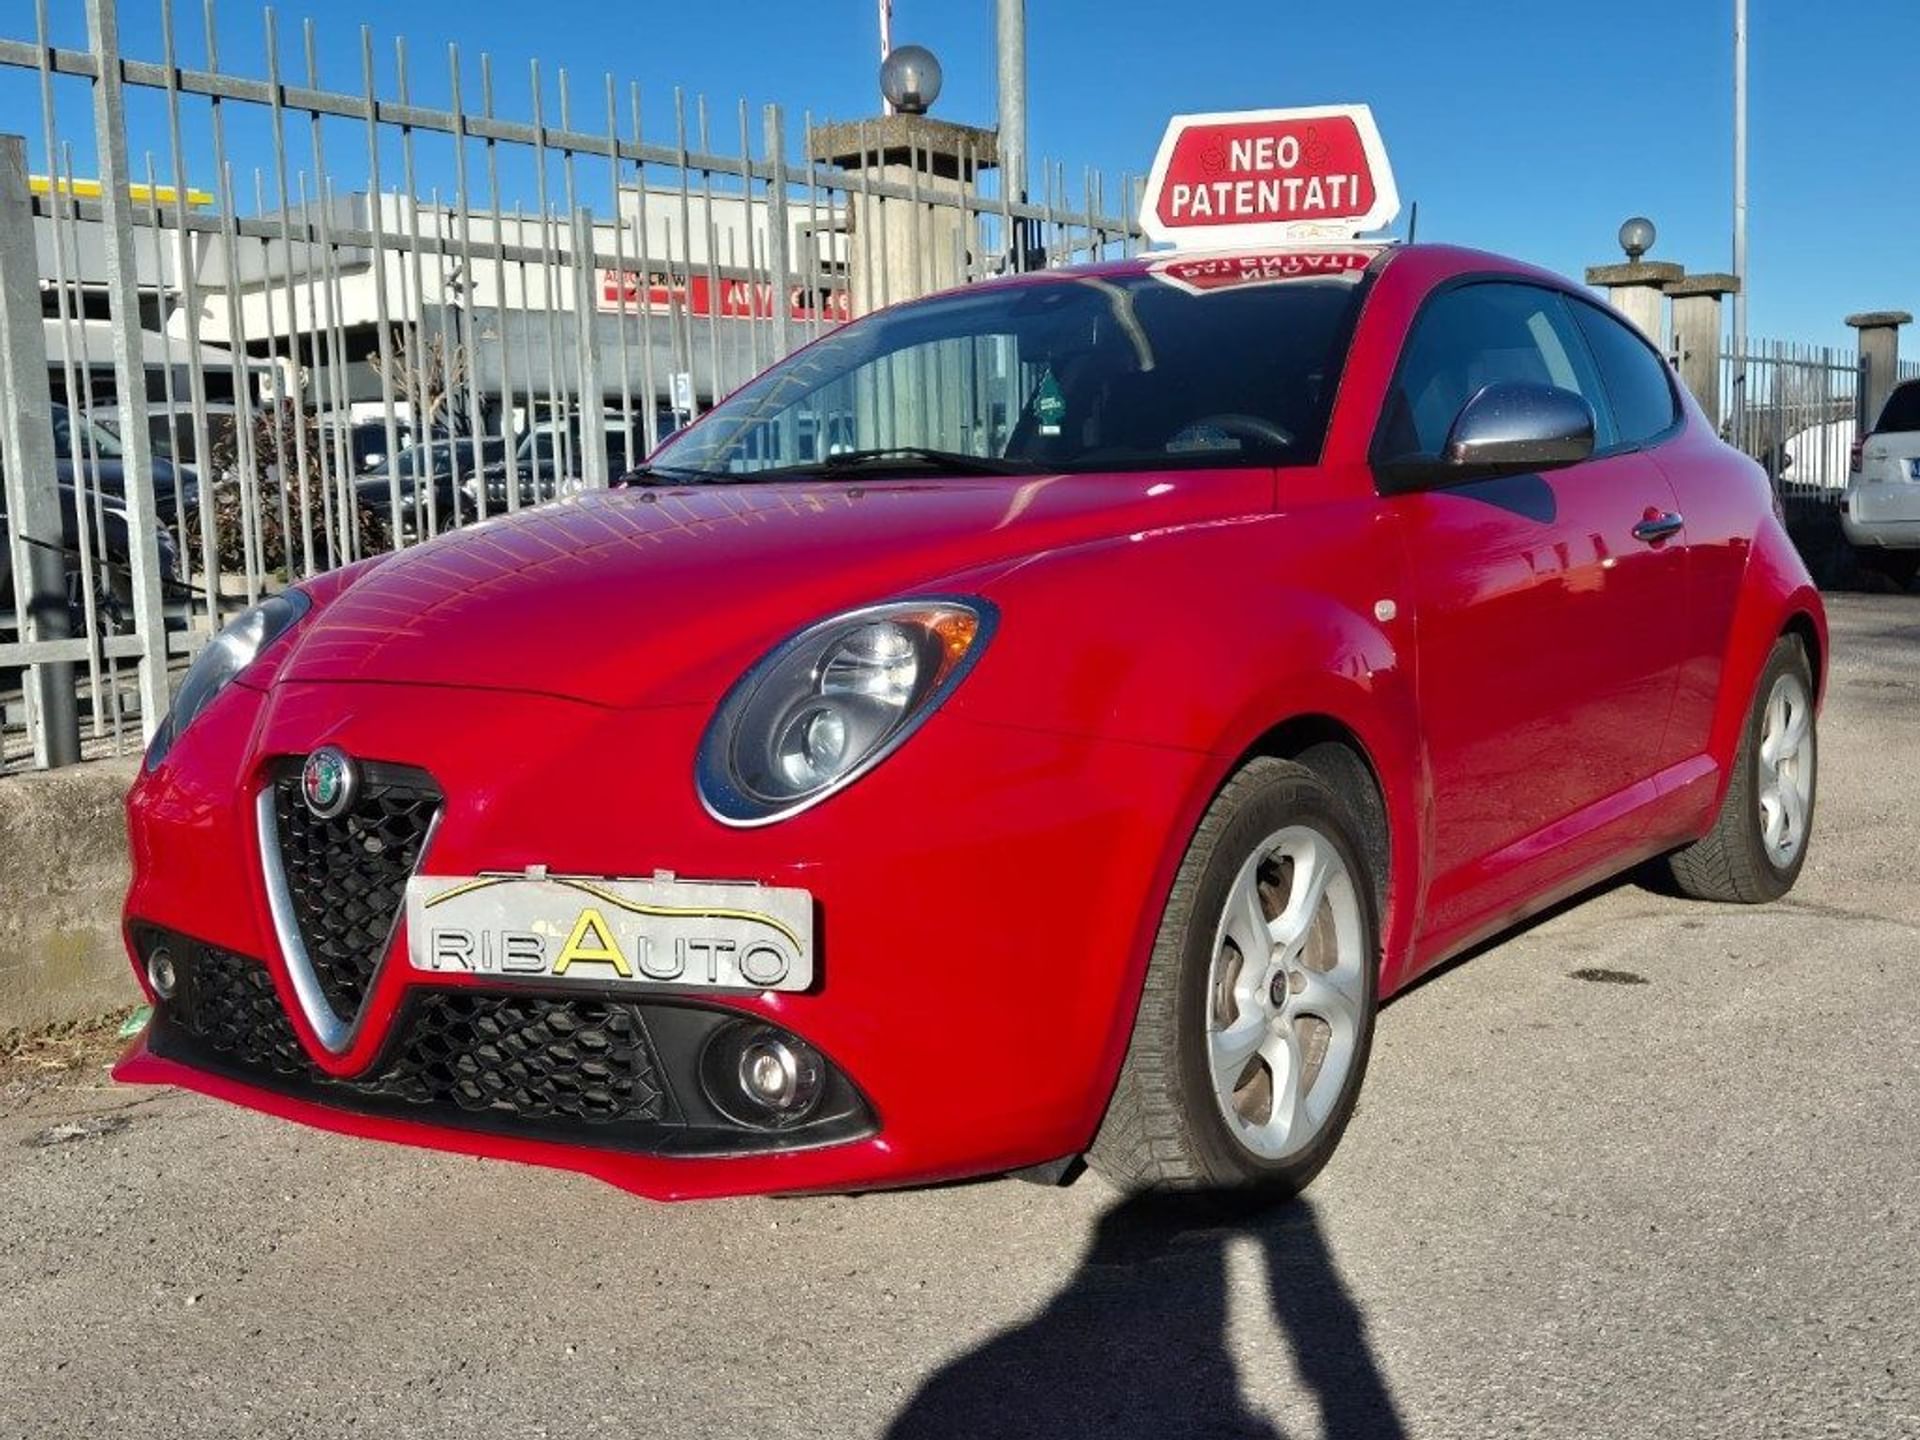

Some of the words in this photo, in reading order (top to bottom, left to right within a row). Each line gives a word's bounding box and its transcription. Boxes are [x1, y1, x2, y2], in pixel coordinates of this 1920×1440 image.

[1230, 136, 1300, 172] NEO
[1171, 174, 1359, 217] PATENTATI
[430, 906, 791, 986] RIBAUTO
